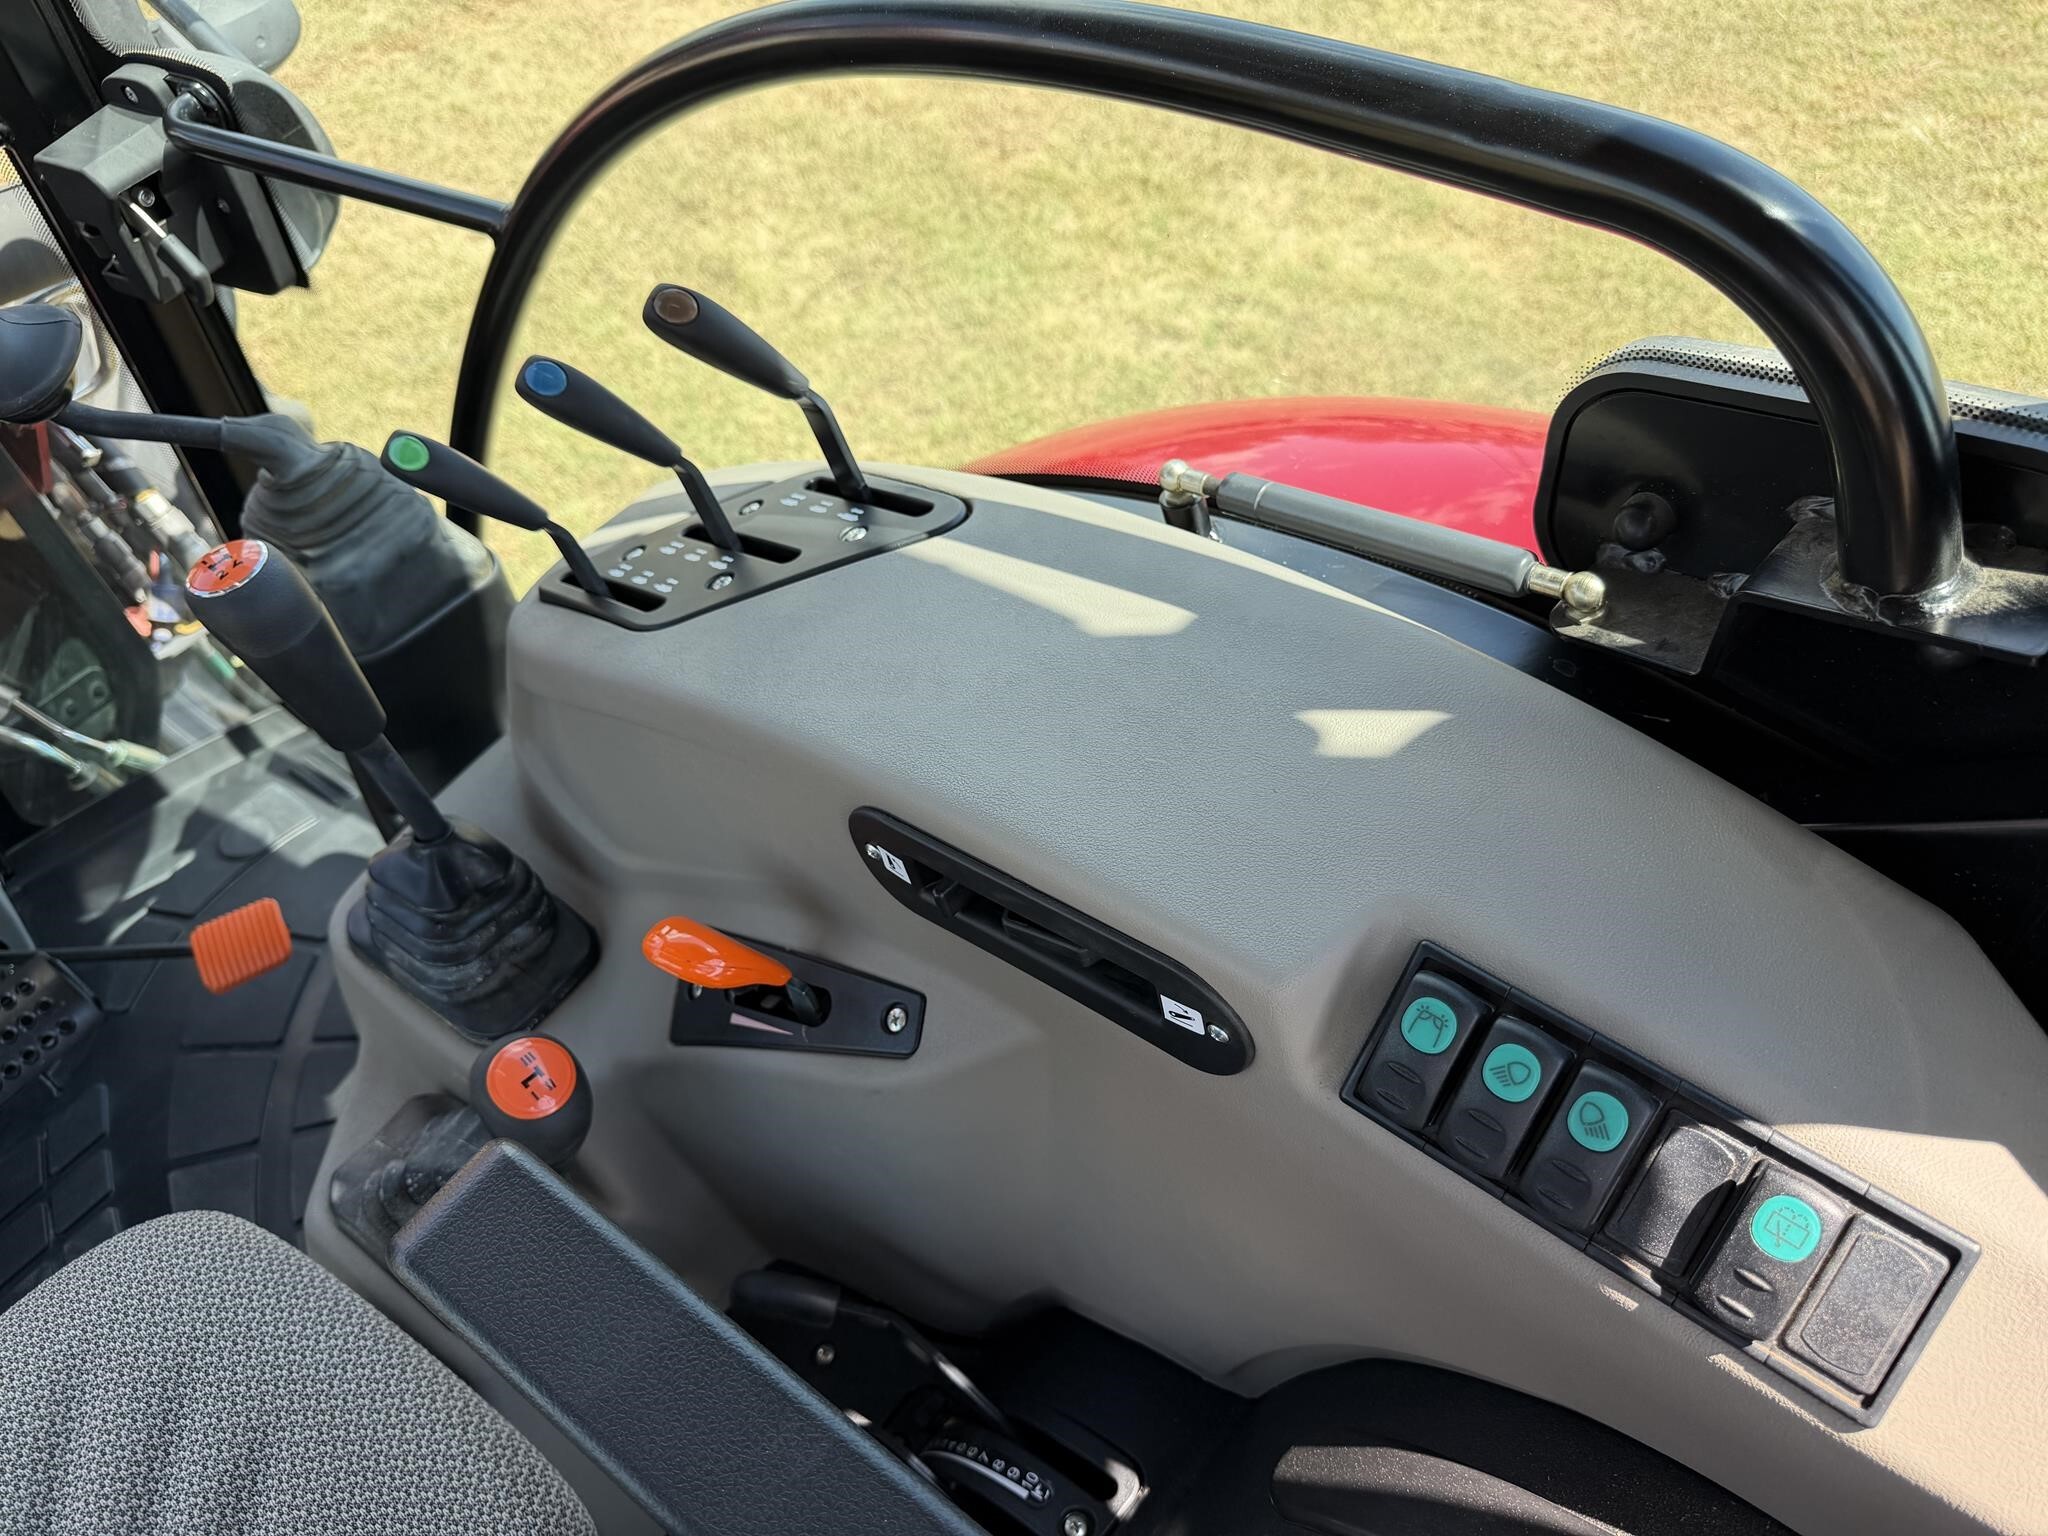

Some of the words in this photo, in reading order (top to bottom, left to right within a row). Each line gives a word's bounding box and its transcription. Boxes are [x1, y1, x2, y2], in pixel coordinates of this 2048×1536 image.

[992, 1459, 1006, 1472] 8
[1007, 1466, 1020, 1480] 9
[1021, 1471, 1039, 1489] 10
